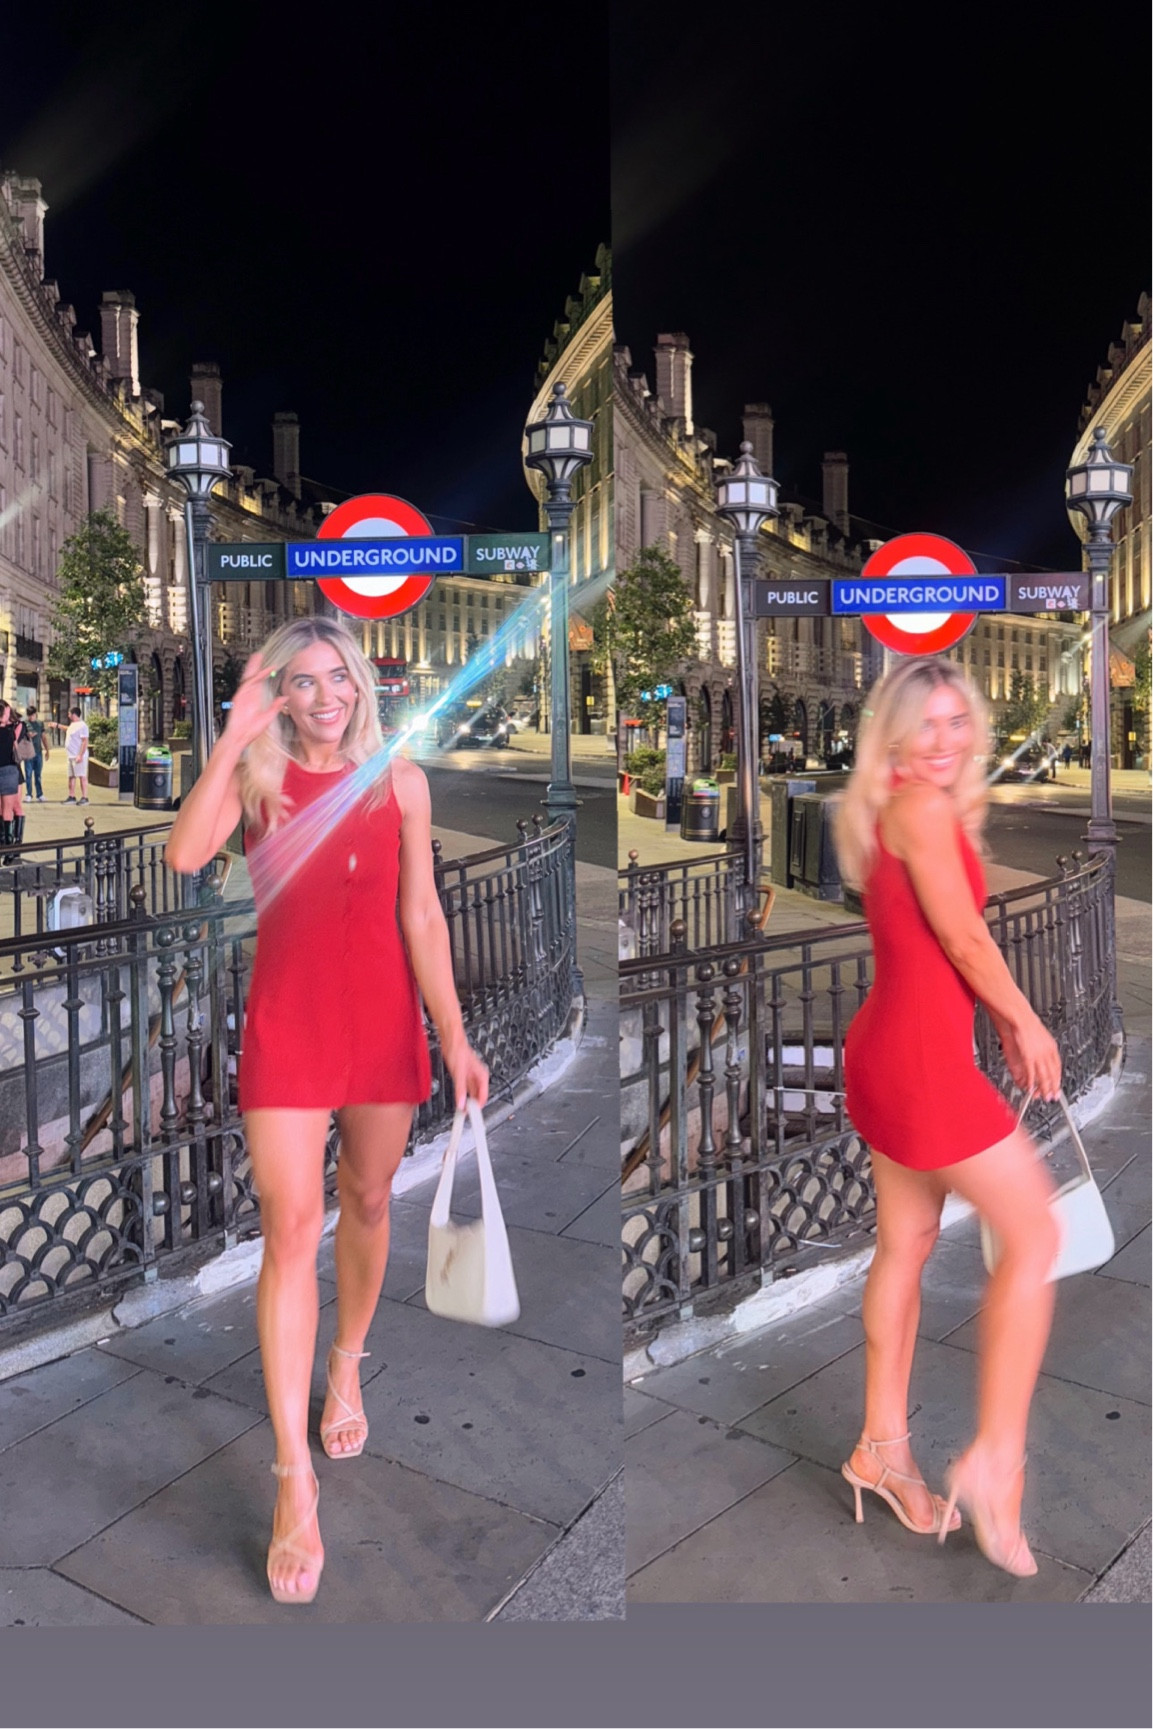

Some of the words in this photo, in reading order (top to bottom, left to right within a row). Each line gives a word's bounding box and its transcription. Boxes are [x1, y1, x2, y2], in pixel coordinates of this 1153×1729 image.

[220, 554, 273, 568] PUBLIC
[295, 546, 457, 568] UNDERGROUND
[476, 545, 540, 561] SUBWAY
[767, 591, 819, 605] PUBLIC
[840, 585, 1000, 605] UNDERGROUND
[1018, 585, 1081, 600] SUBWAY
